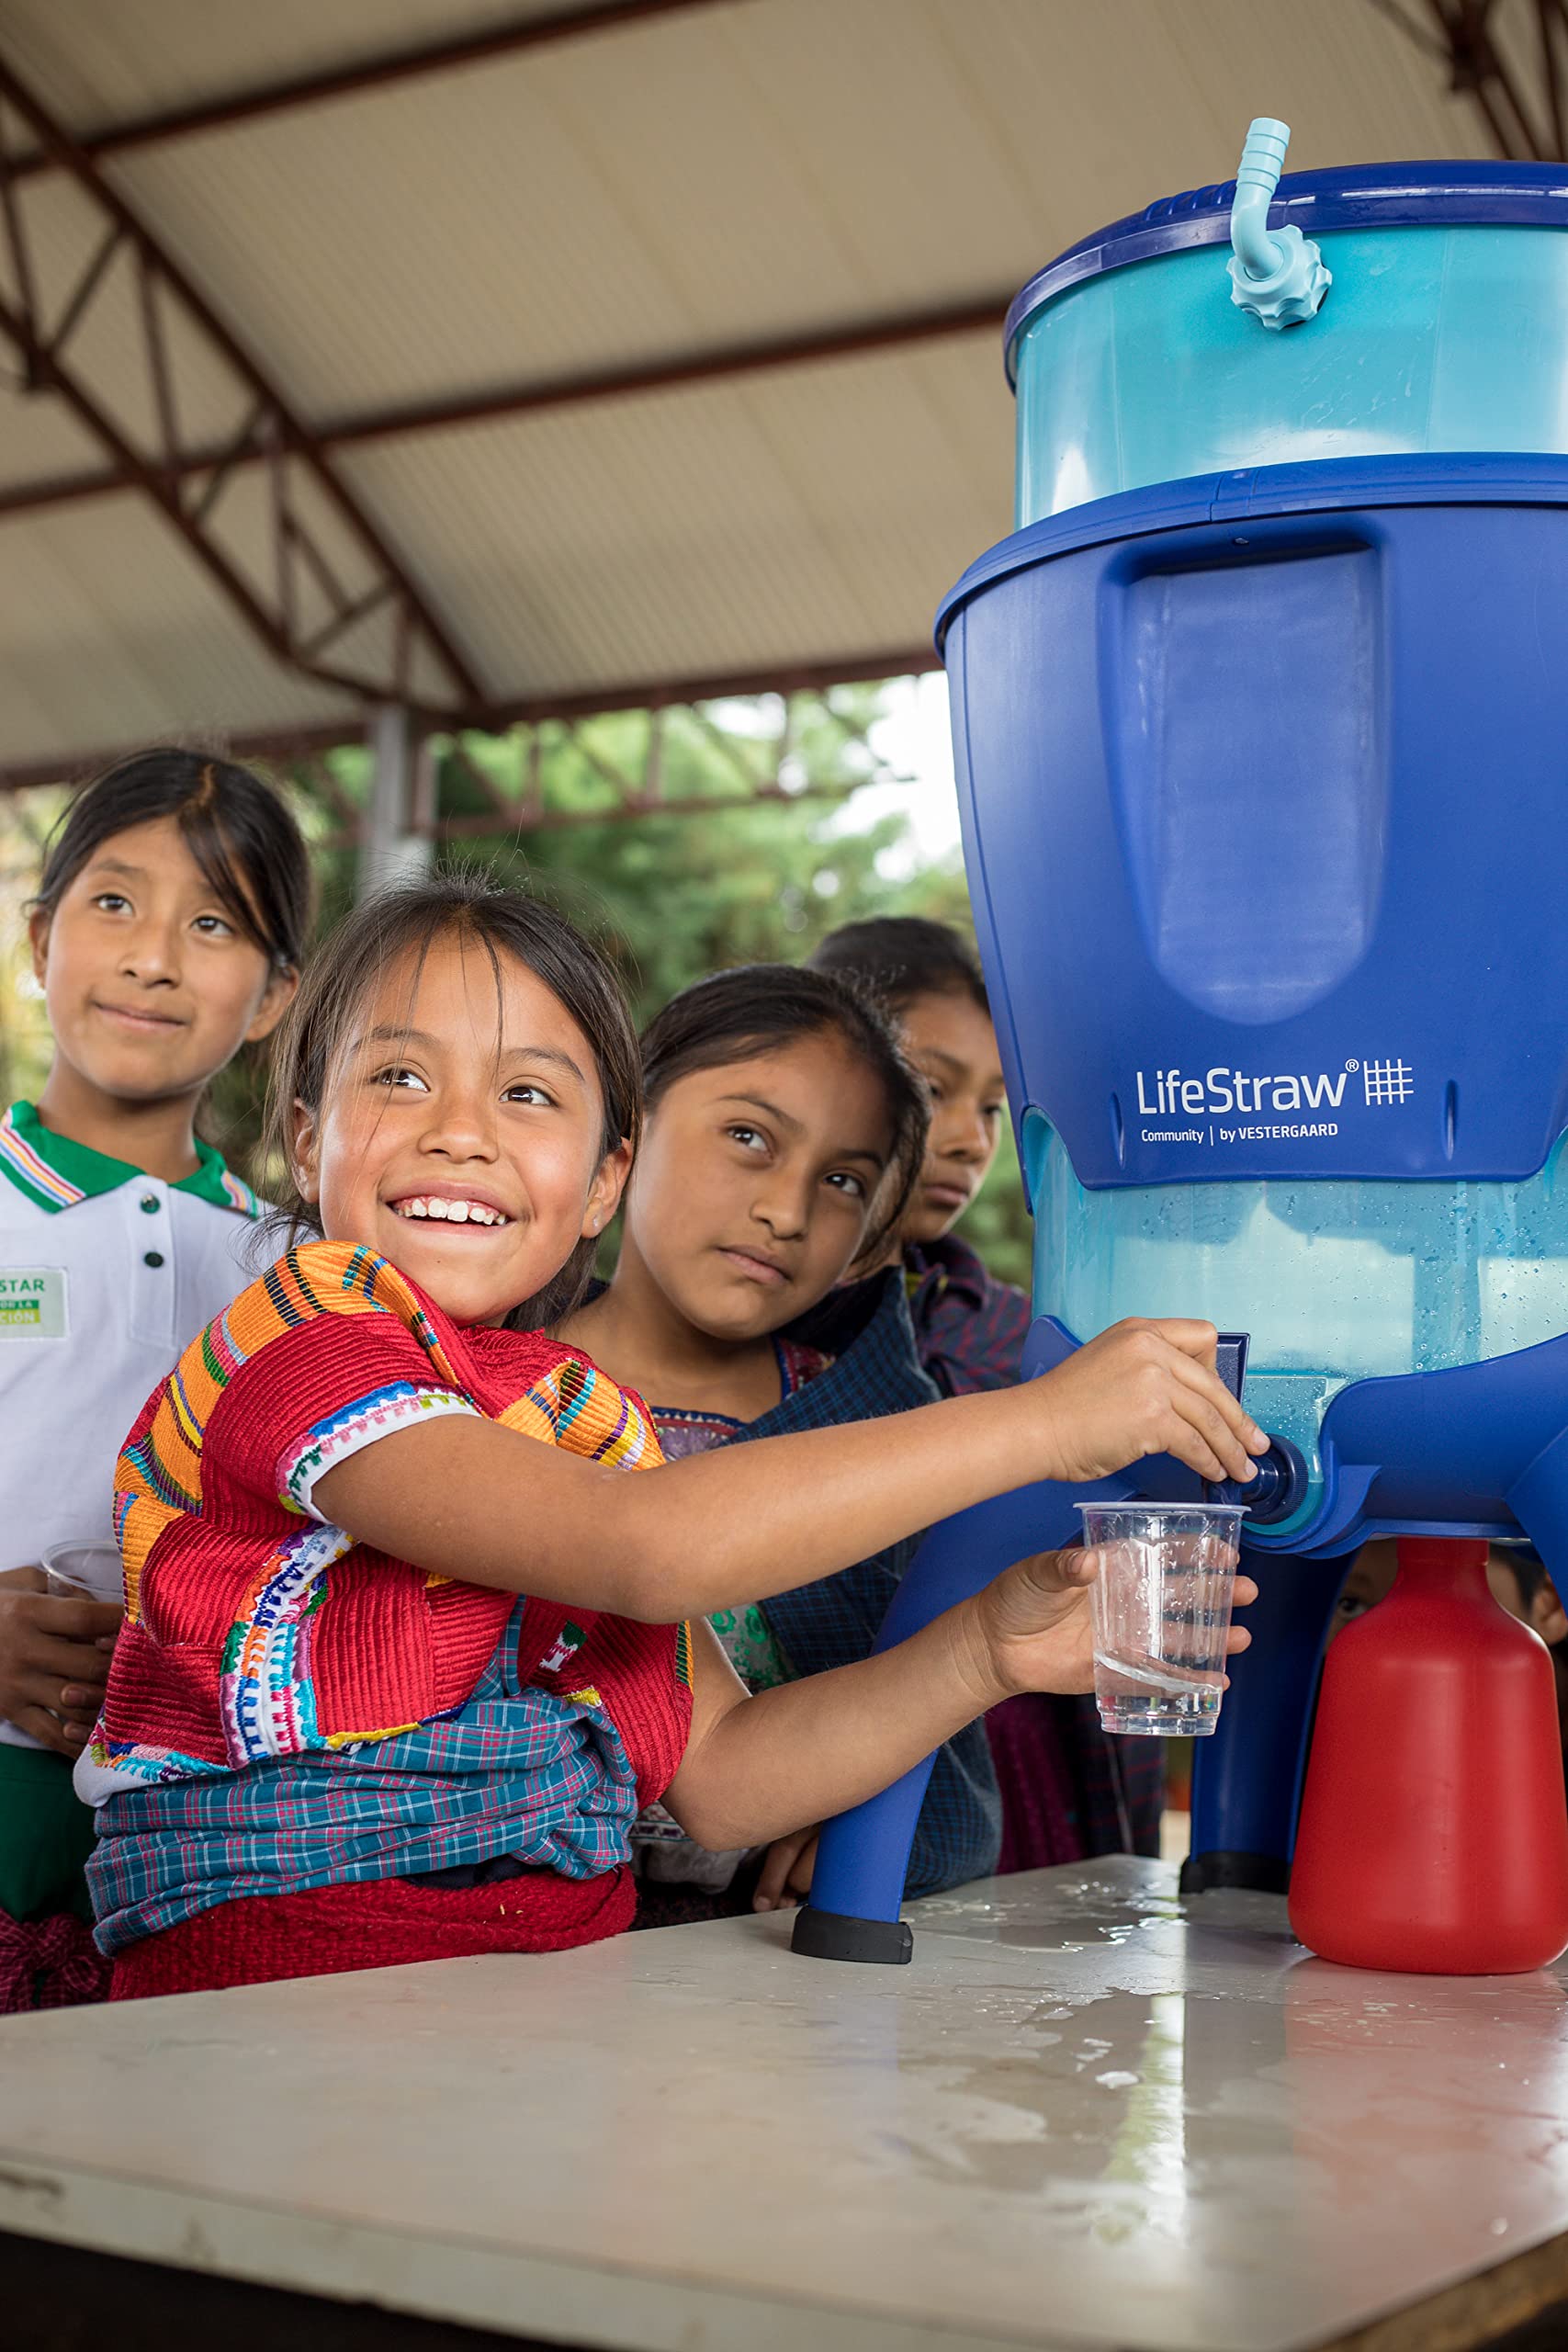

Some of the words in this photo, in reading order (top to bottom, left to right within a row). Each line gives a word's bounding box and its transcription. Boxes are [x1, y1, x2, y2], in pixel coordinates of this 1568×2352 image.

[1141, 1129, 1204, 1145] Community
[1219, 1127, 1236, 1143] by
[1237, 1123, 1338, 1140] VESTERGAARD
[0, 1278, 45, 1293] STAR
